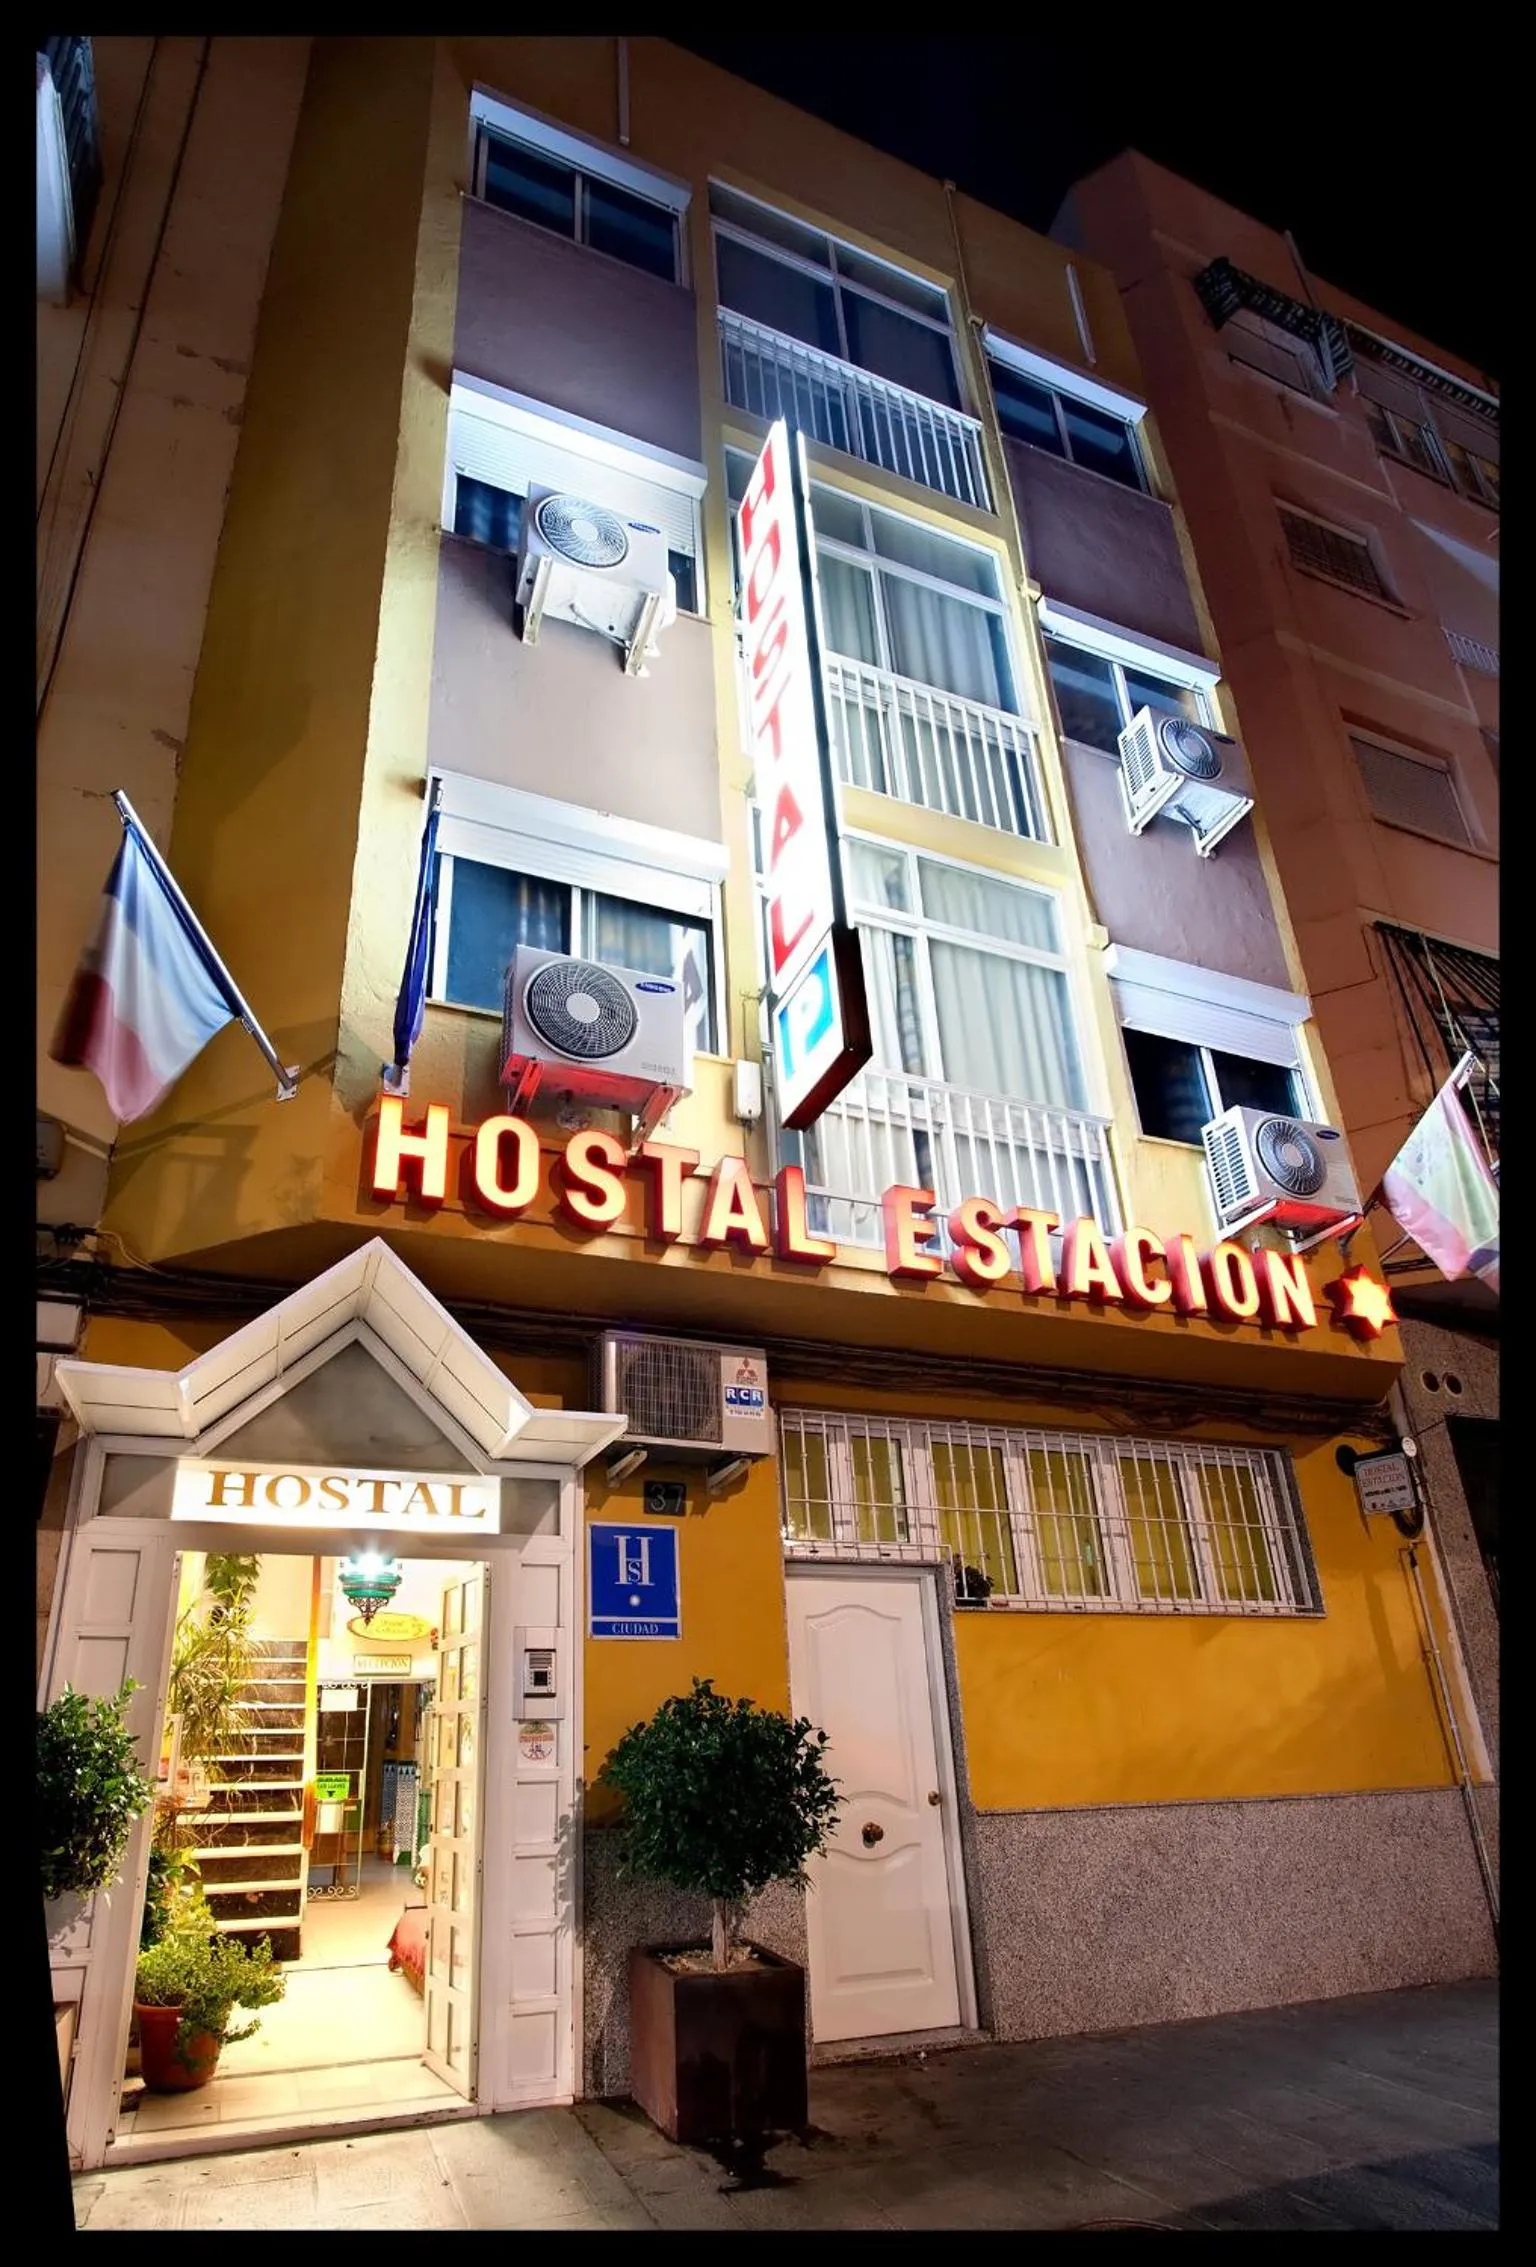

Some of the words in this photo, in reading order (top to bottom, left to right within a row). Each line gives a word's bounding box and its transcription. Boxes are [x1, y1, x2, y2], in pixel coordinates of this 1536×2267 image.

[741, 437, 814, 978] HOSTAL
[784, 968, 825, 1075] P
[372, 1096, 836, 1266] HOSTAL
[882, 1184, 1318, 1333] ESTACION
[726, 1388, 762, 1402] RCR
[205, 1470, 486, 1518] HOSTAL
[650, 1484, 683, 1512] 37
[612, 1622, 659, 1635] CIUDAD
